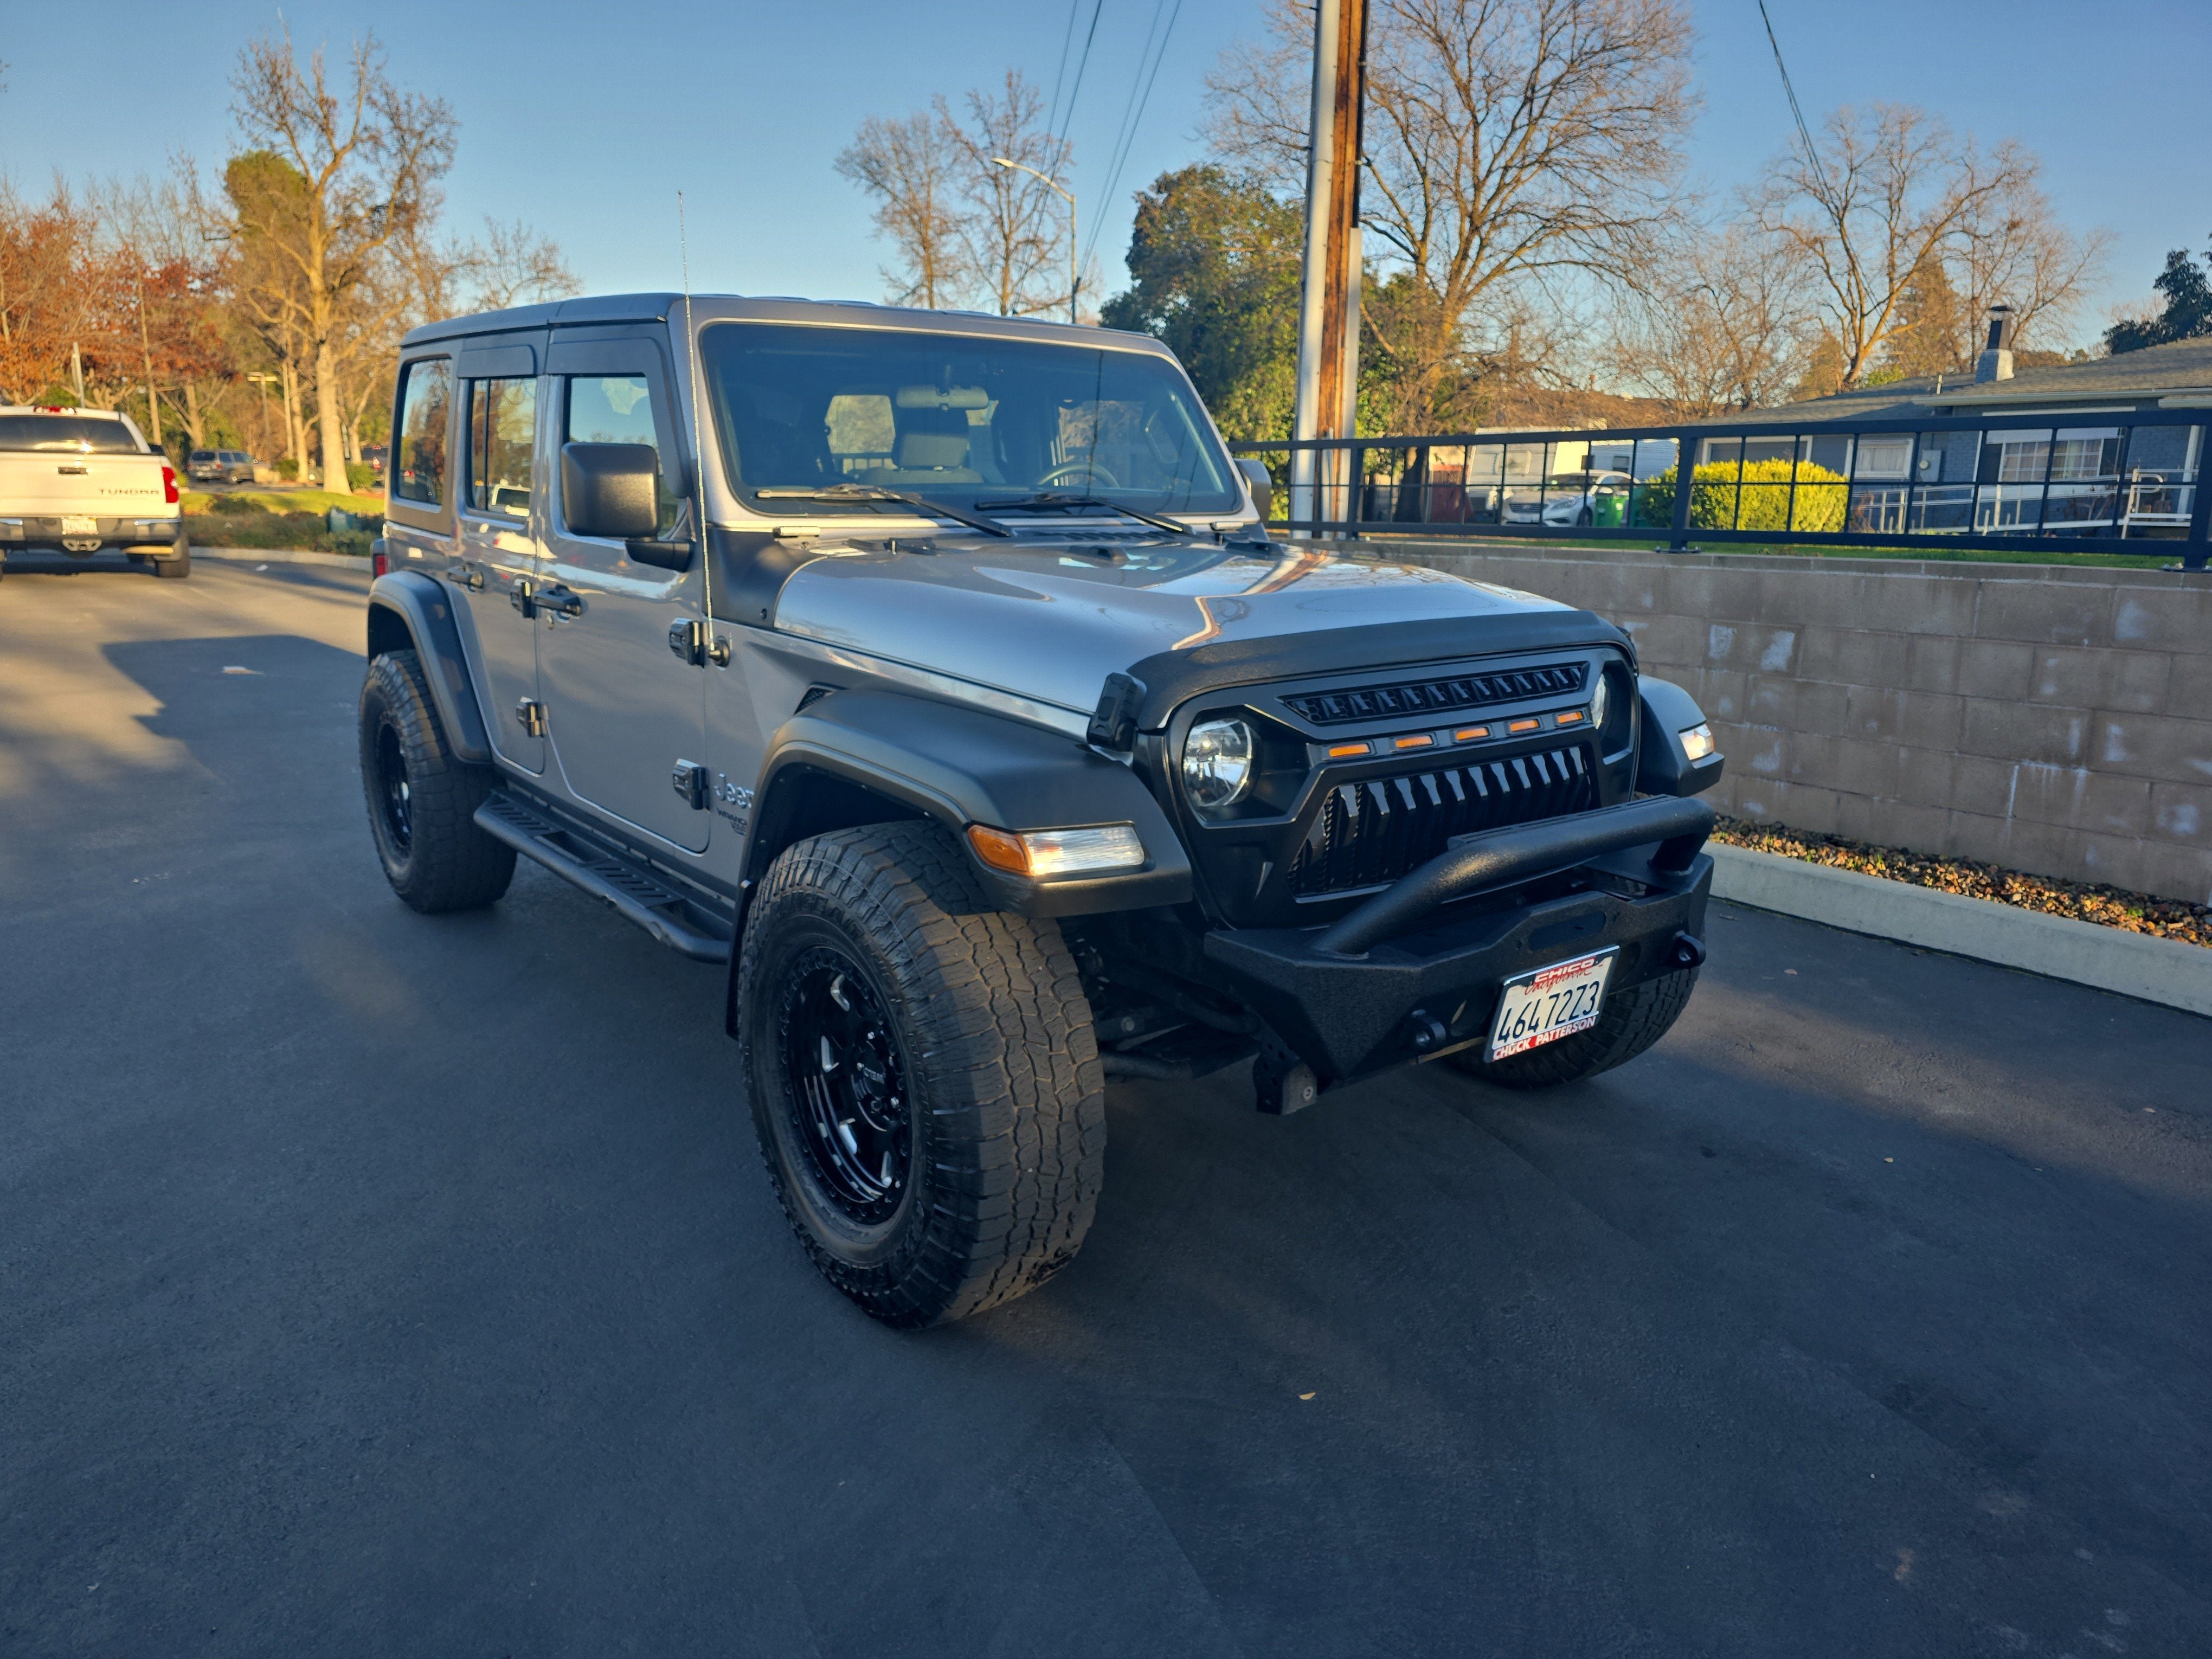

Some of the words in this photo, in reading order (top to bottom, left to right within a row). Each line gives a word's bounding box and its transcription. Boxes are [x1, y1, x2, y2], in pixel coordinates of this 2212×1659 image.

[1534, 958, 1595, 983] CHICO
[1497, 981, 1600, 1043] 46472Z3
[1493, 1037, 1531, 1062] CHUCK
[1535, 1016, 1596, 1047] PATTERSON
